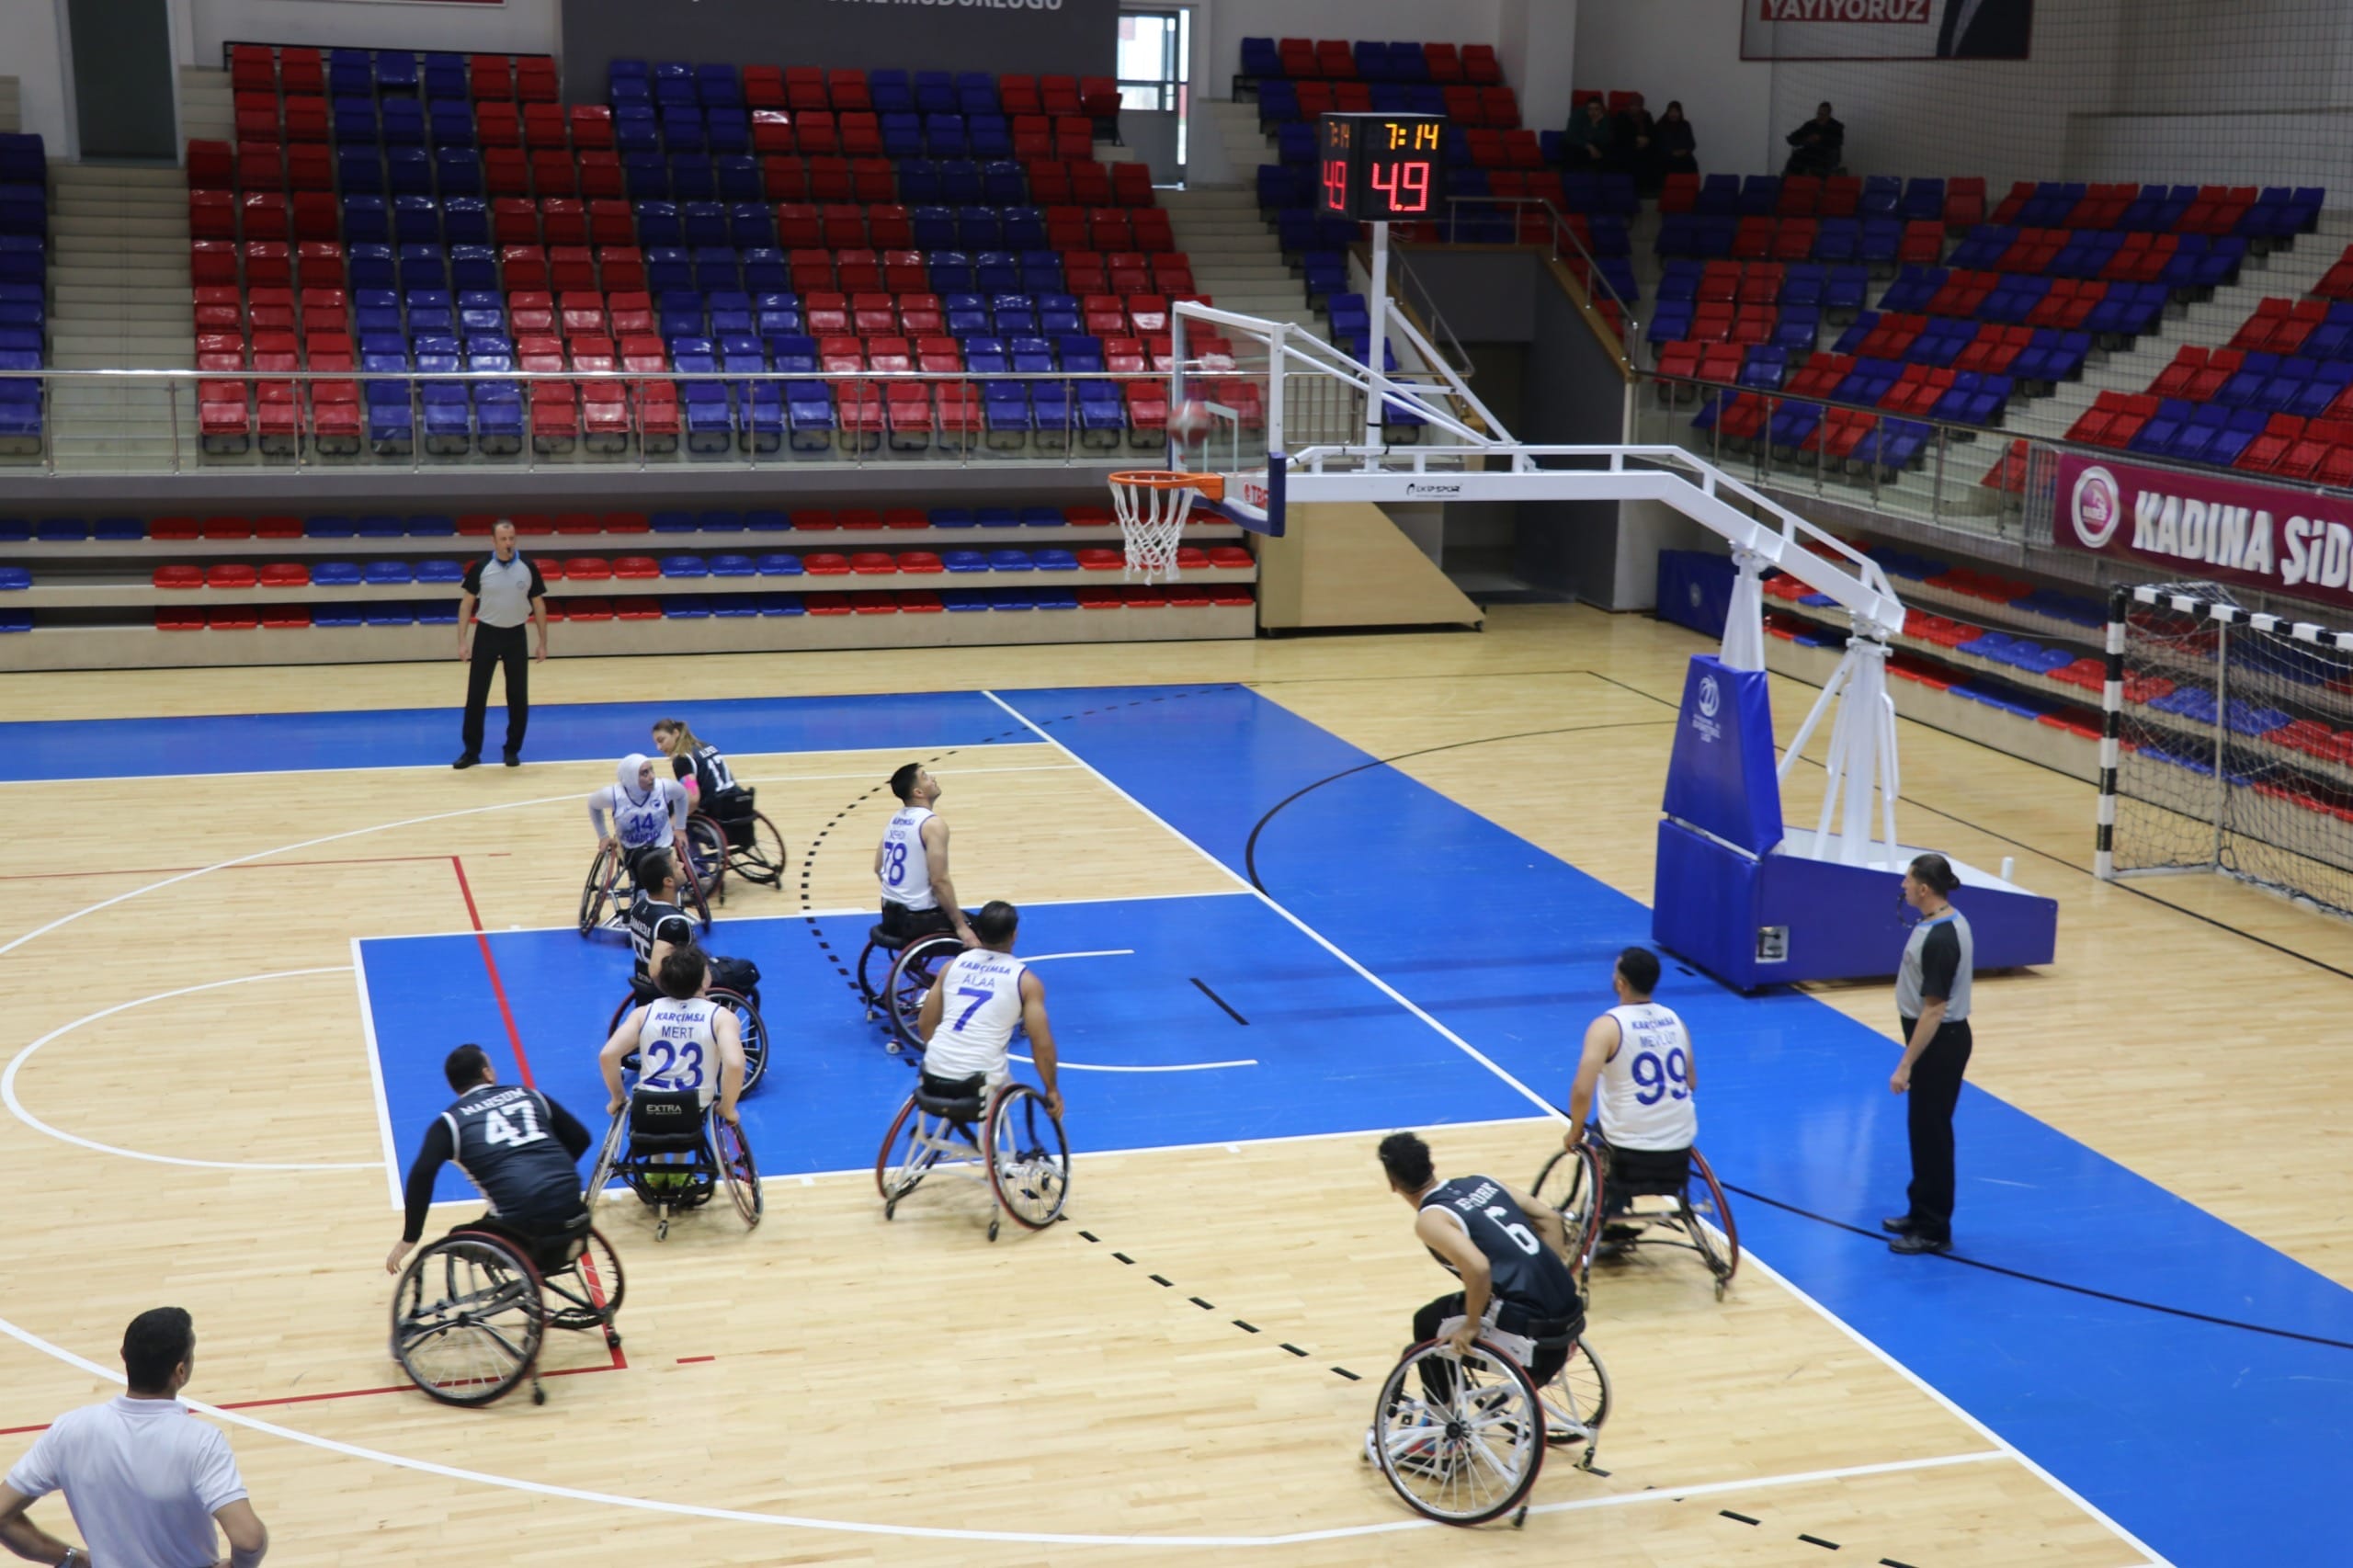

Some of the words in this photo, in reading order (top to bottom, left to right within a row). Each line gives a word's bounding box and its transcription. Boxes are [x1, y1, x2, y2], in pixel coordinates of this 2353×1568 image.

[1384, 123, 1439, 151] 7:14
[1371, 162, 1430, 211] 49
[2131, 490, 2273, 574] KADINA
[707, 754, 735, 792] 17
[631, 812, 656, 832] 14
[884, 841, 907, 886] 78
[962, 974, 995, 987] ALAA
[952, 986, 994, 1032] 7
[662, 1025, 694, 1039] MERT
[643, 1040, 704, 1091] 23
[1631, 1047, 1688, 1106] 99
[485, 1099, 549, 1146] 47
[646, 1104, 682, 1112] EXTRA
[1483, 1206, 1540, 1256] 6
